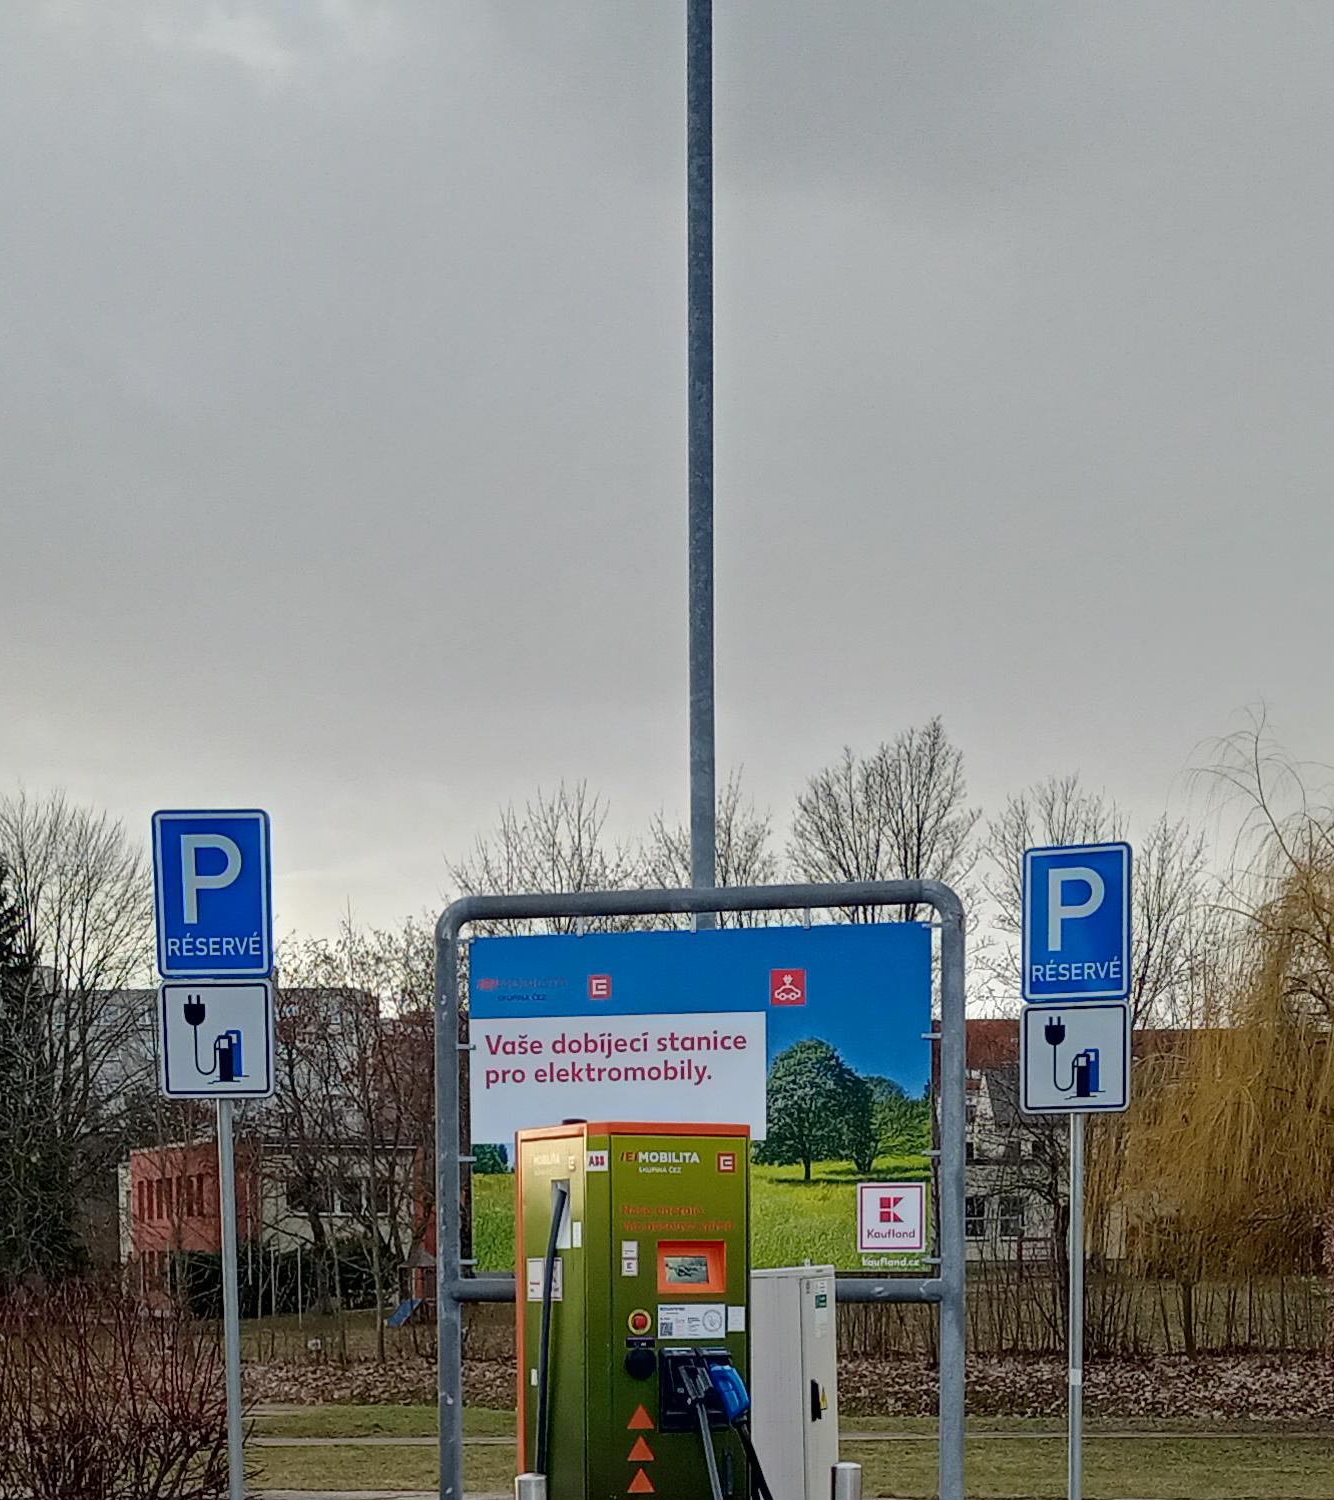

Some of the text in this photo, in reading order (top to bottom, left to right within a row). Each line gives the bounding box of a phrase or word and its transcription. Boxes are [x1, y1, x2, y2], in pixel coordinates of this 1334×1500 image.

[180, 833, 242, 925] P
[1047, 866, 1106, 952] P
[167, 931, 261, 957] RÉSERVÉ
[1032, 956, 1121, 982] RÉSERVÉ
[485, 1030, 747, 1059] Vaše dobíjecí stanice
[485, 1059, 712, 1089] pro elektromobily.
[588, 1155, 605, 1166] ABB
[867, 1228, 915, 1239] Kaufland
[862, 1256, 920, 1267] kaufland.cz
